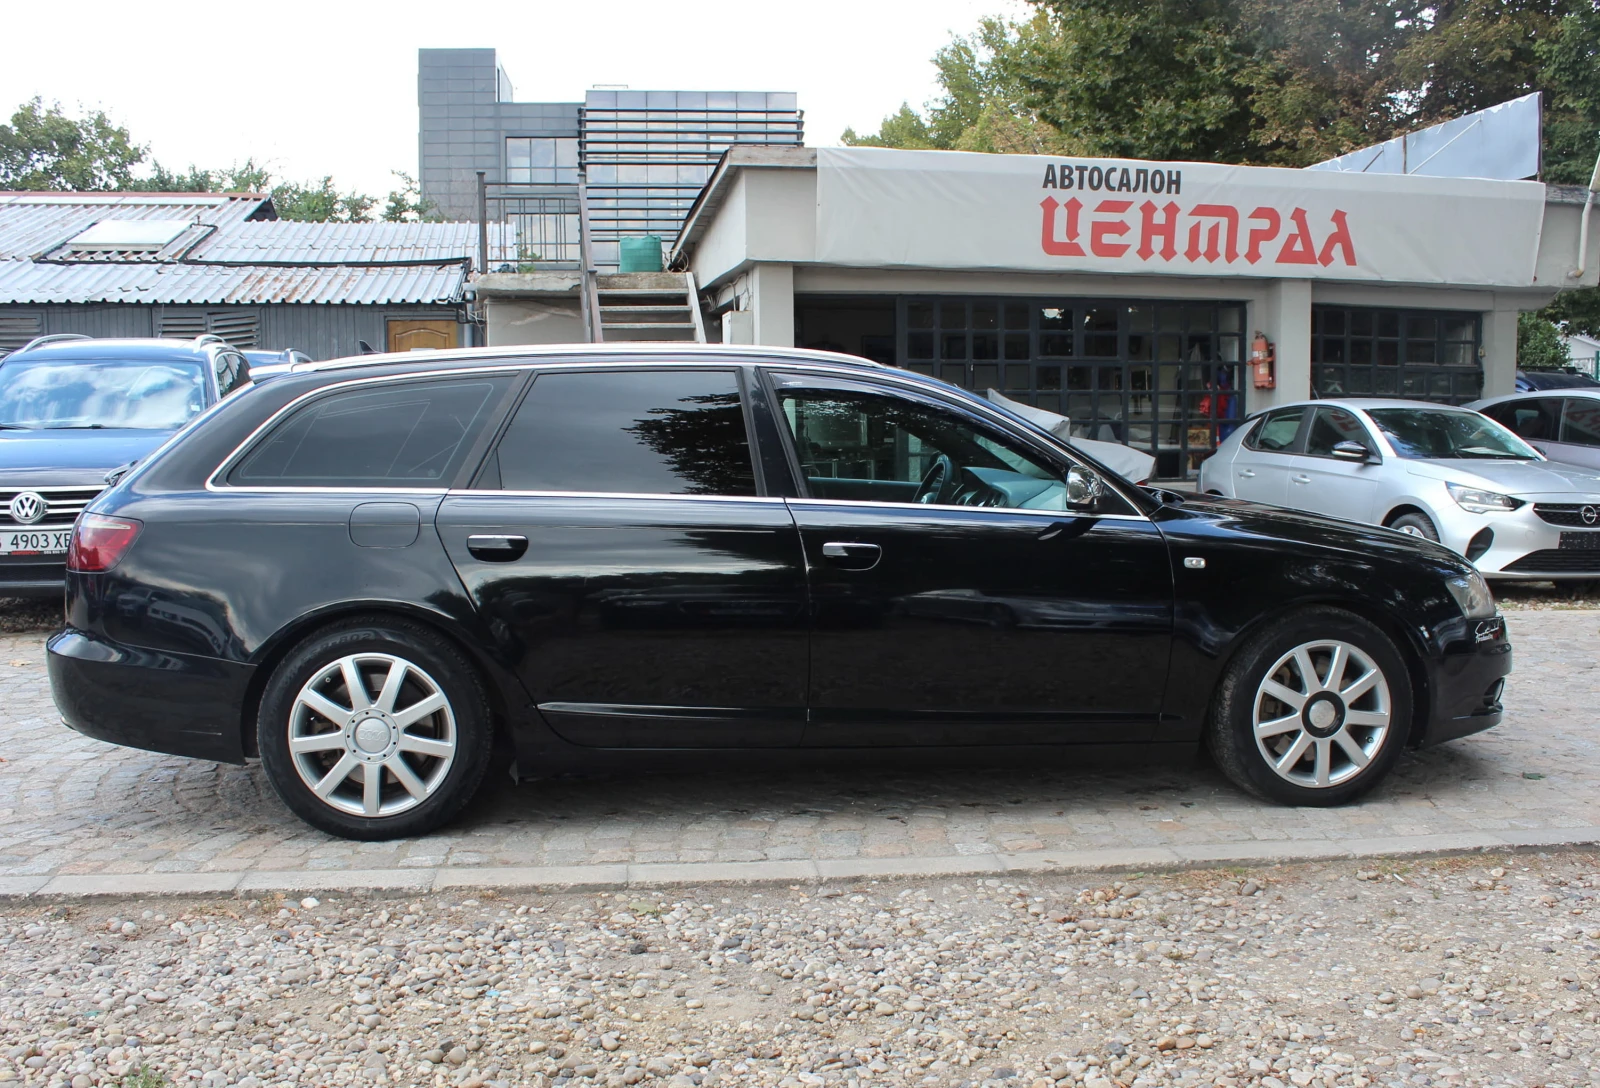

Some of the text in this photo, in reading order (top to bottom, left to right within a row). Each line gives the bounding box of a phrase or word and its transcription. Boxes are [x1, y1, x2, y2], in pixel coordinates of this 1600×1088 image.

[1042, 164, 1182, 195] АВТОСАЛОН
[1039, 195, 1357, 268] ЦЕНТРАЛ
[10, 533, 49, 549] 4903
